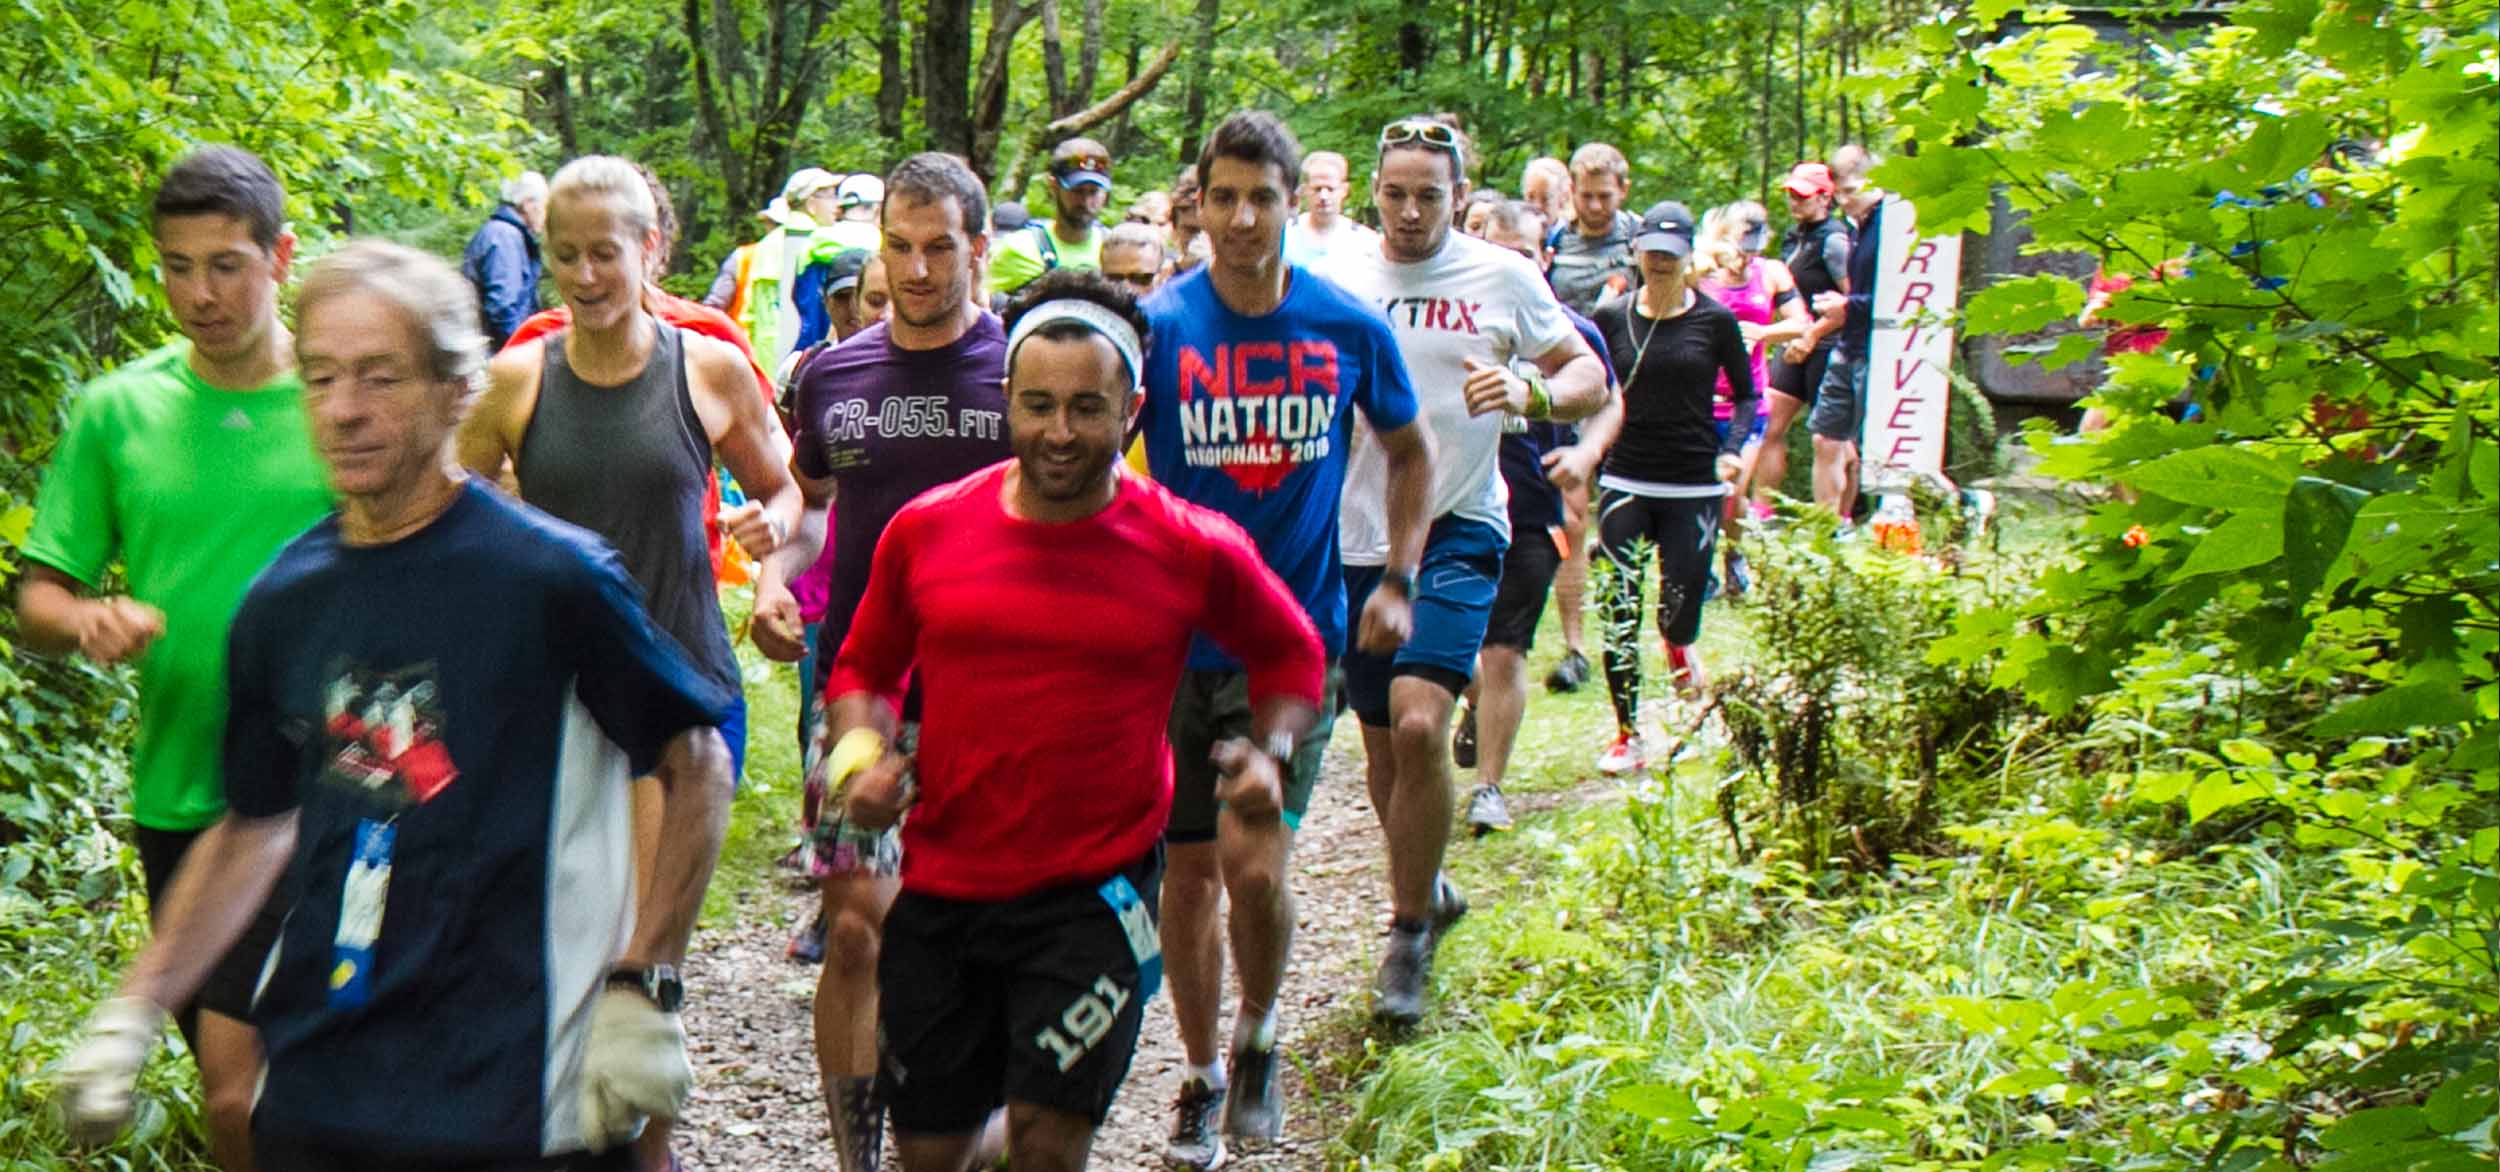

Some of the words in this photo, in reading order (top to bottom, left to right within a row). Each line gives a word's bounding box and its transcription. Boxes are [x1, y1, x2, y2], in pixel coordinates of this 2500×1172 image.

[1178, 339, 1340, 401] NCR
[960, 408, 1002, 440] FIT
[1179, 394, 1337, 445] NATION
[1036, 973, 1131, 1073] 191
